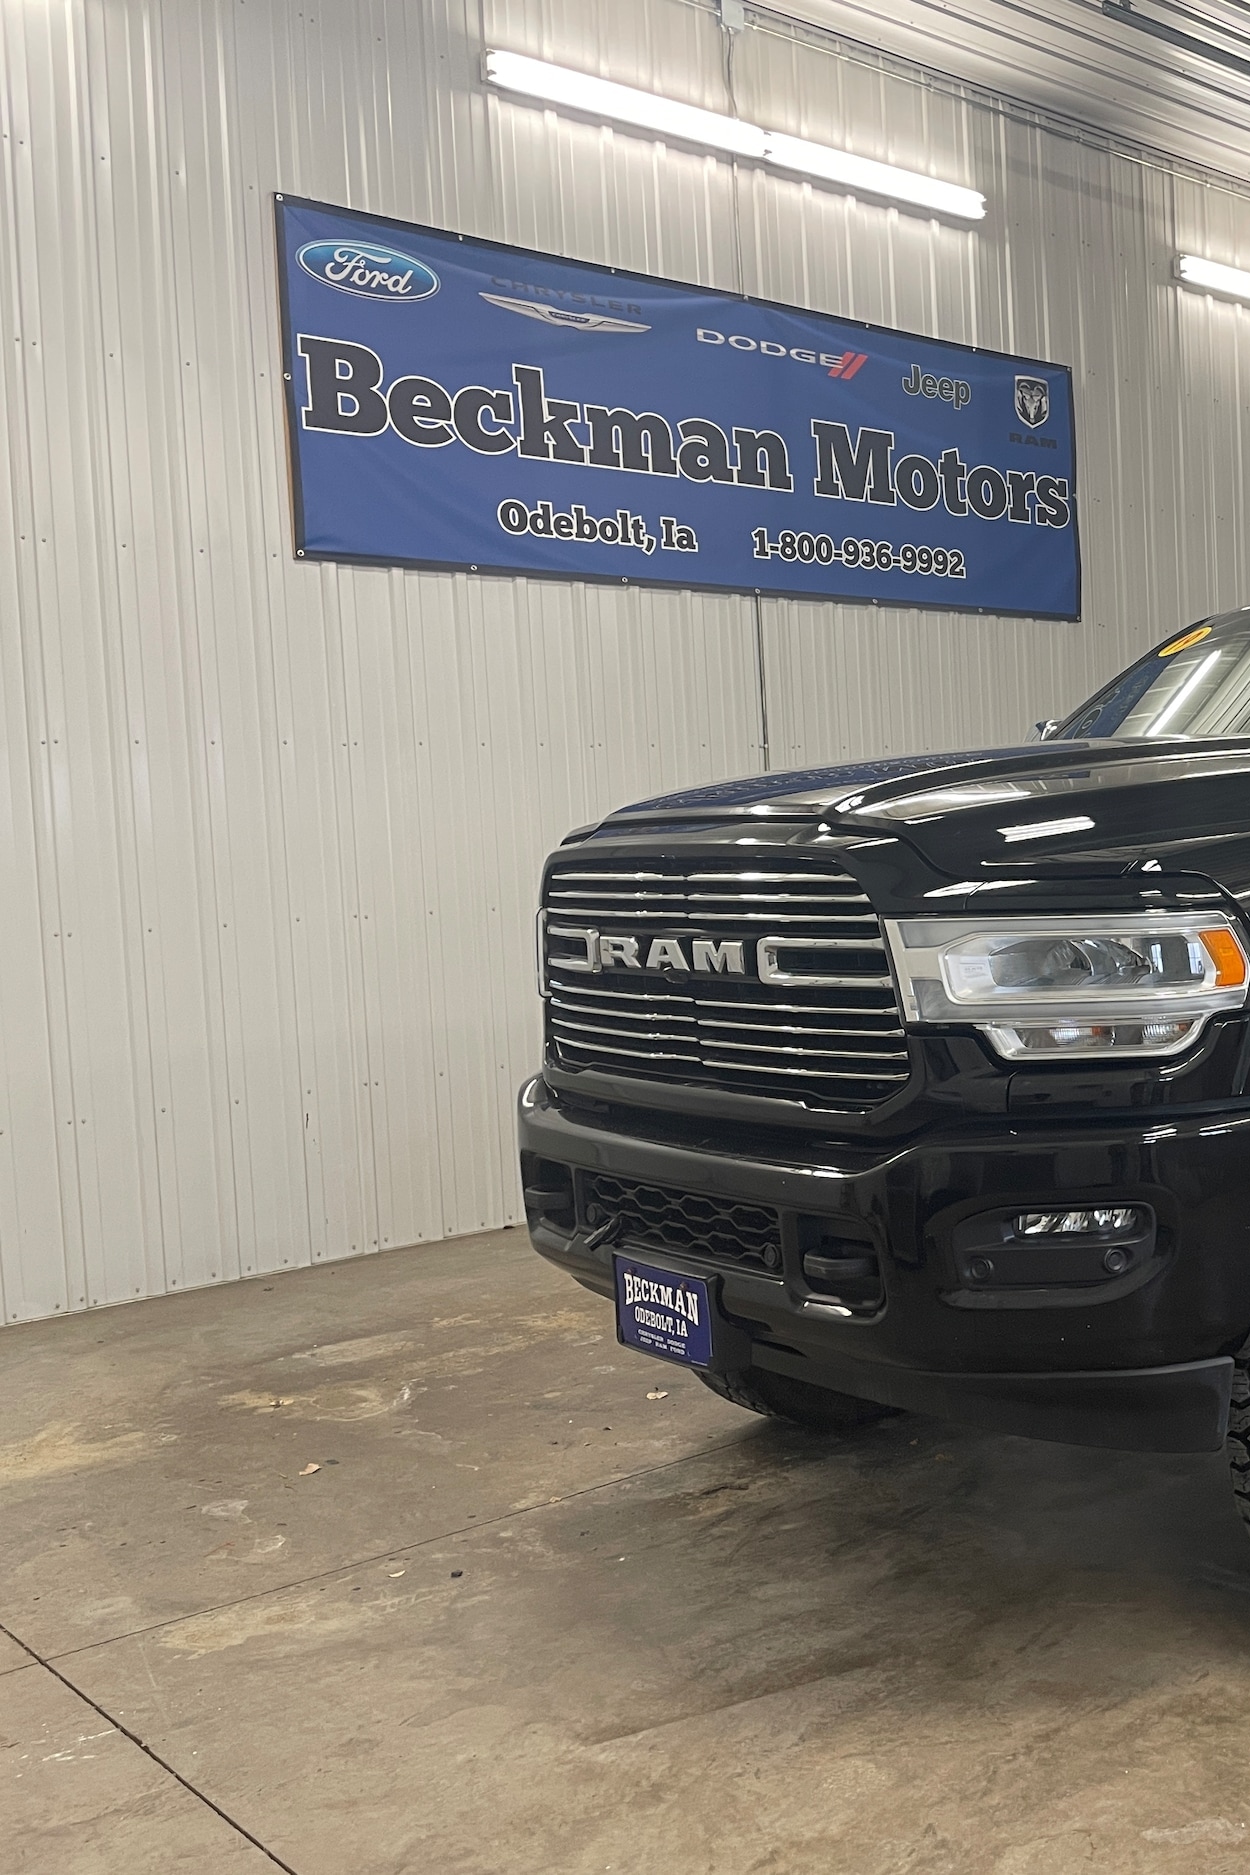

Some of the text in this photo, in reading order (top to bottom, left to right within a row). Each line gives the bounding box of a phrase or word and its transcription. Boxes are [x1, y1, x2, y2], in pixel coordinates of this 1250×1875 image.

[325, 246, 414, 296] Ford
[491, 275, 642, 315] CHRYSLER
[696, 328, 845, 369] DODGE
[902, 363, 971, 410] Jeep
[297, 333, 1071, 529] Beckman Motors
[1009, 432, 1057, 449] RAM
[497, 498, 698, 555] Odebolt, Ia
[751, 527, 967, 579] 1-800-936-9992
[600, 936, 745, 974] RAM
[624, 1273, 699, 1326] BECKMAN
[634, 1305, 688, 1337] ODEBOLT, IA
